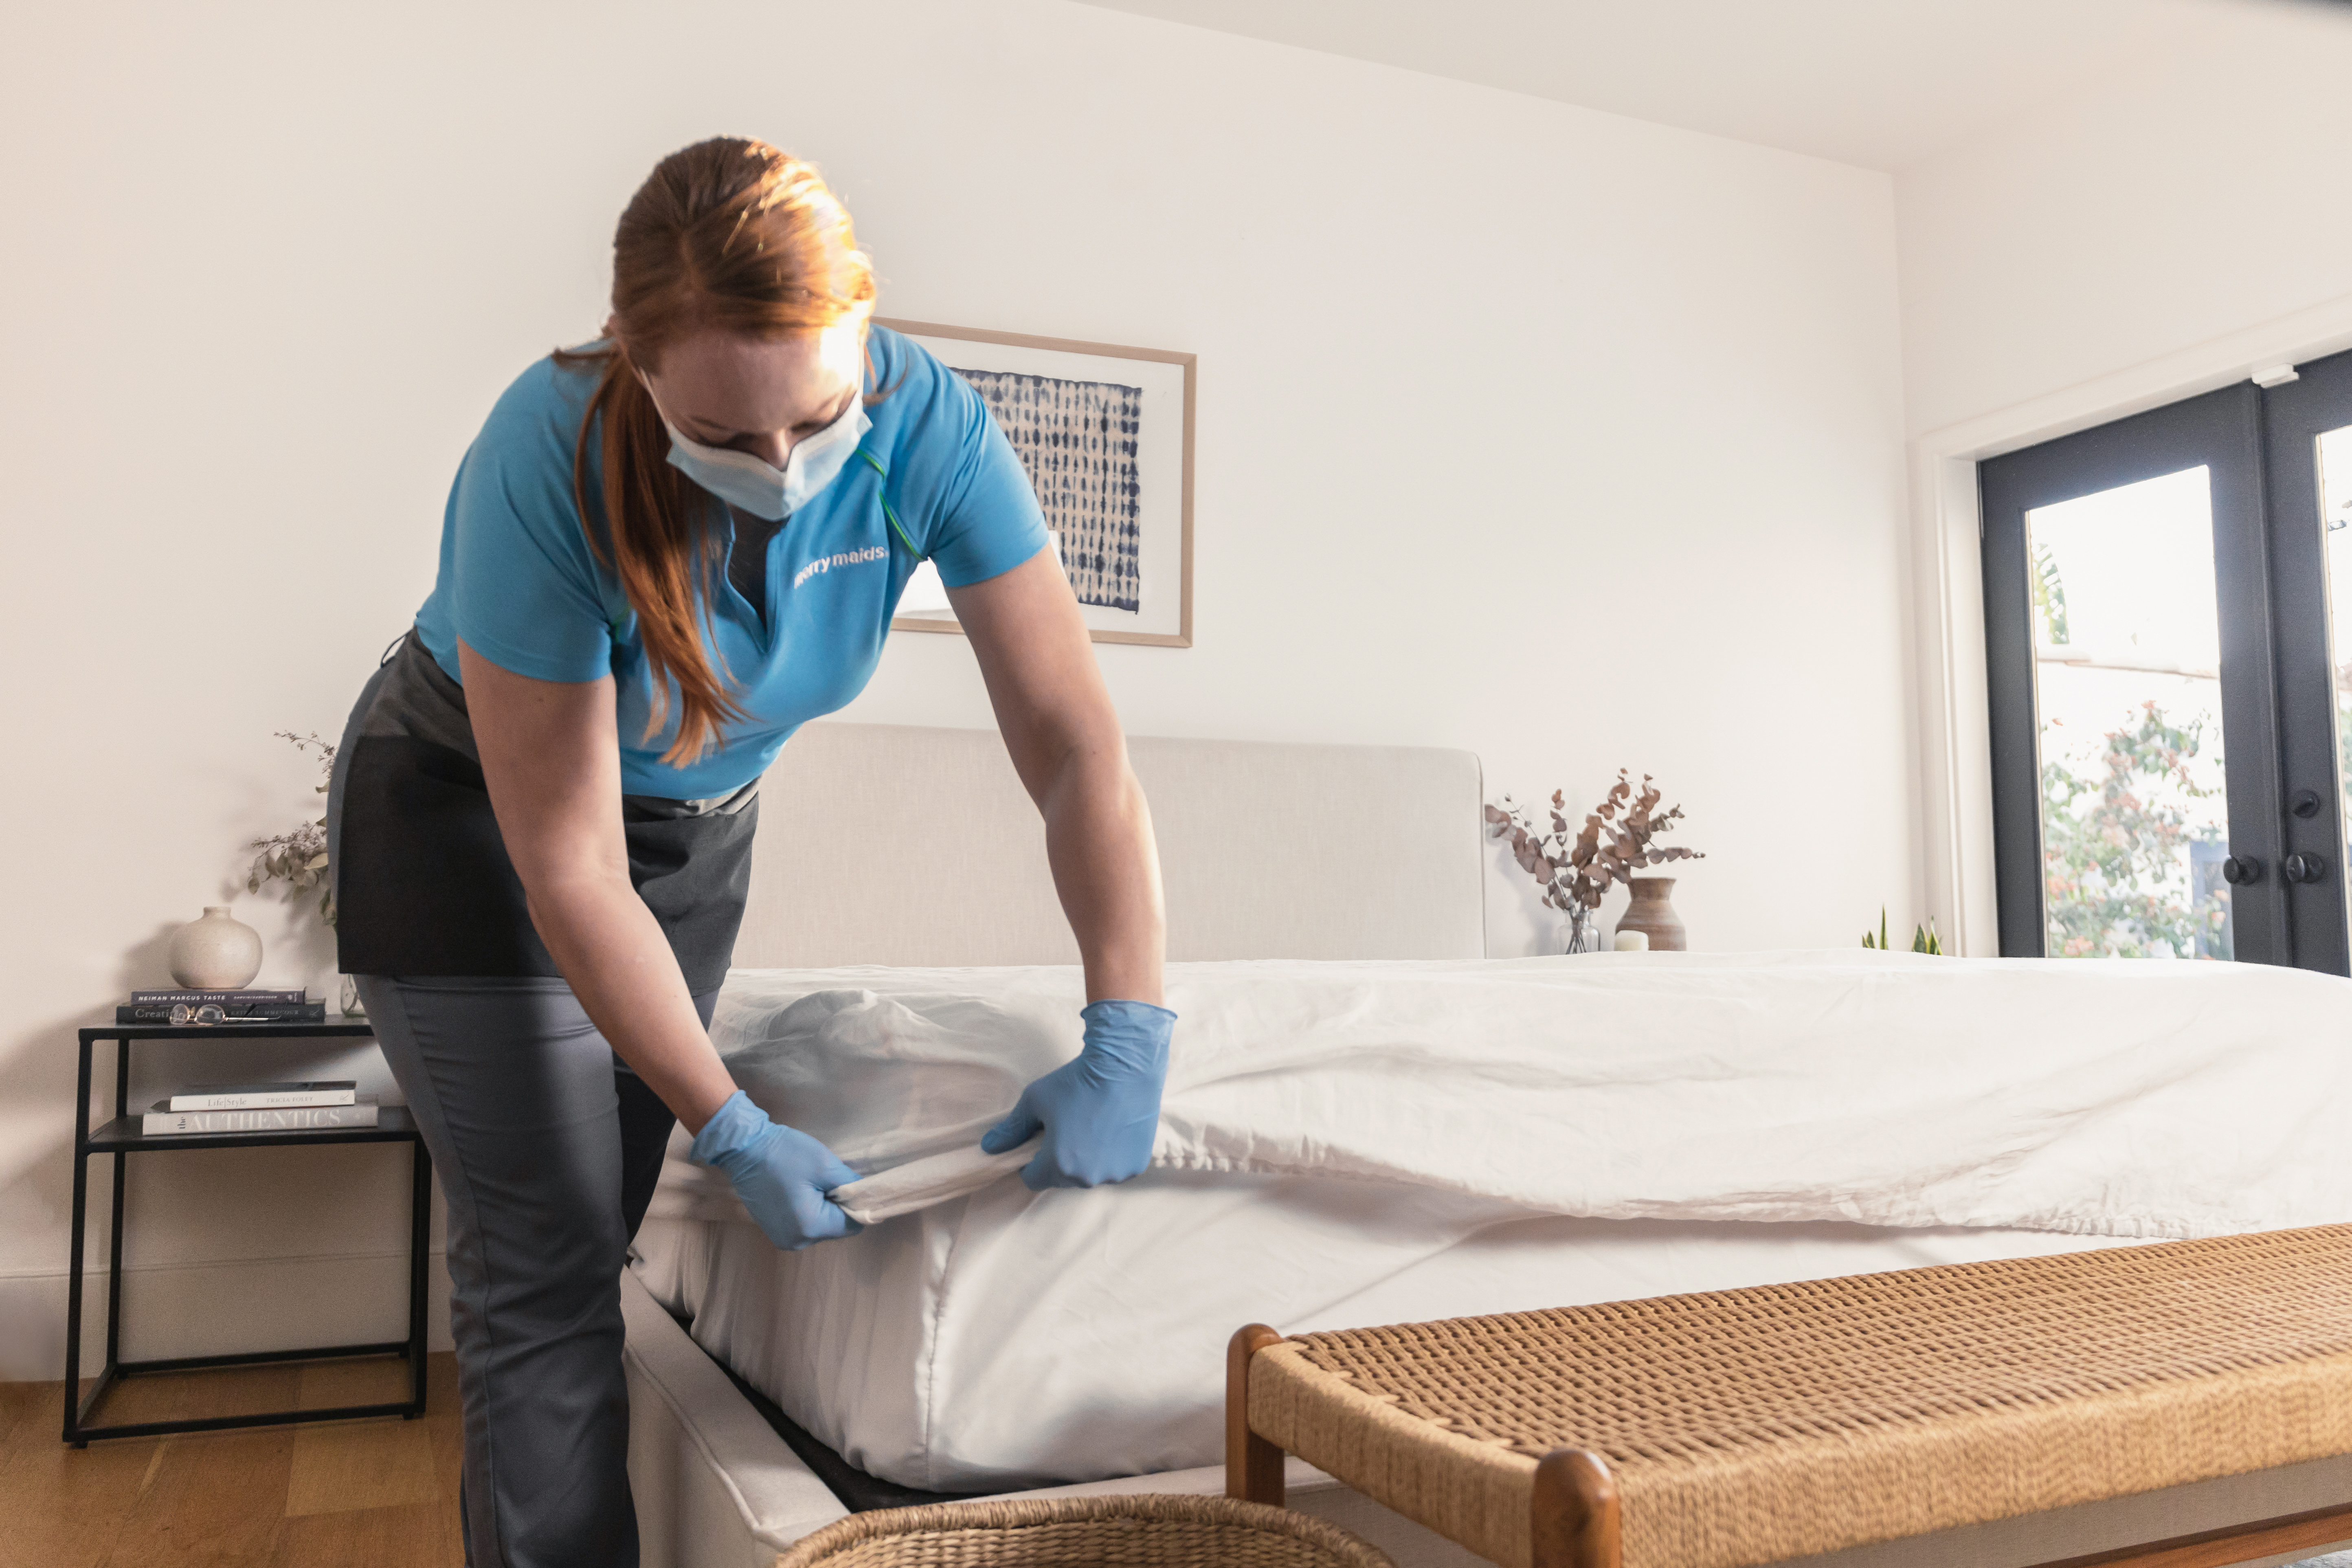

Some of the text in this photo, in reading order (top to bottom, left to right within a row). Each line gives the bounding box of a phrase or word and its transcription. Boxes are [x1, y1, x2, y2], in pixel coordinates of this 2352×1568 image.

[795, 557, 830, 589] merry
[177, 1109, 341, 1131] the AUTHENTICS
